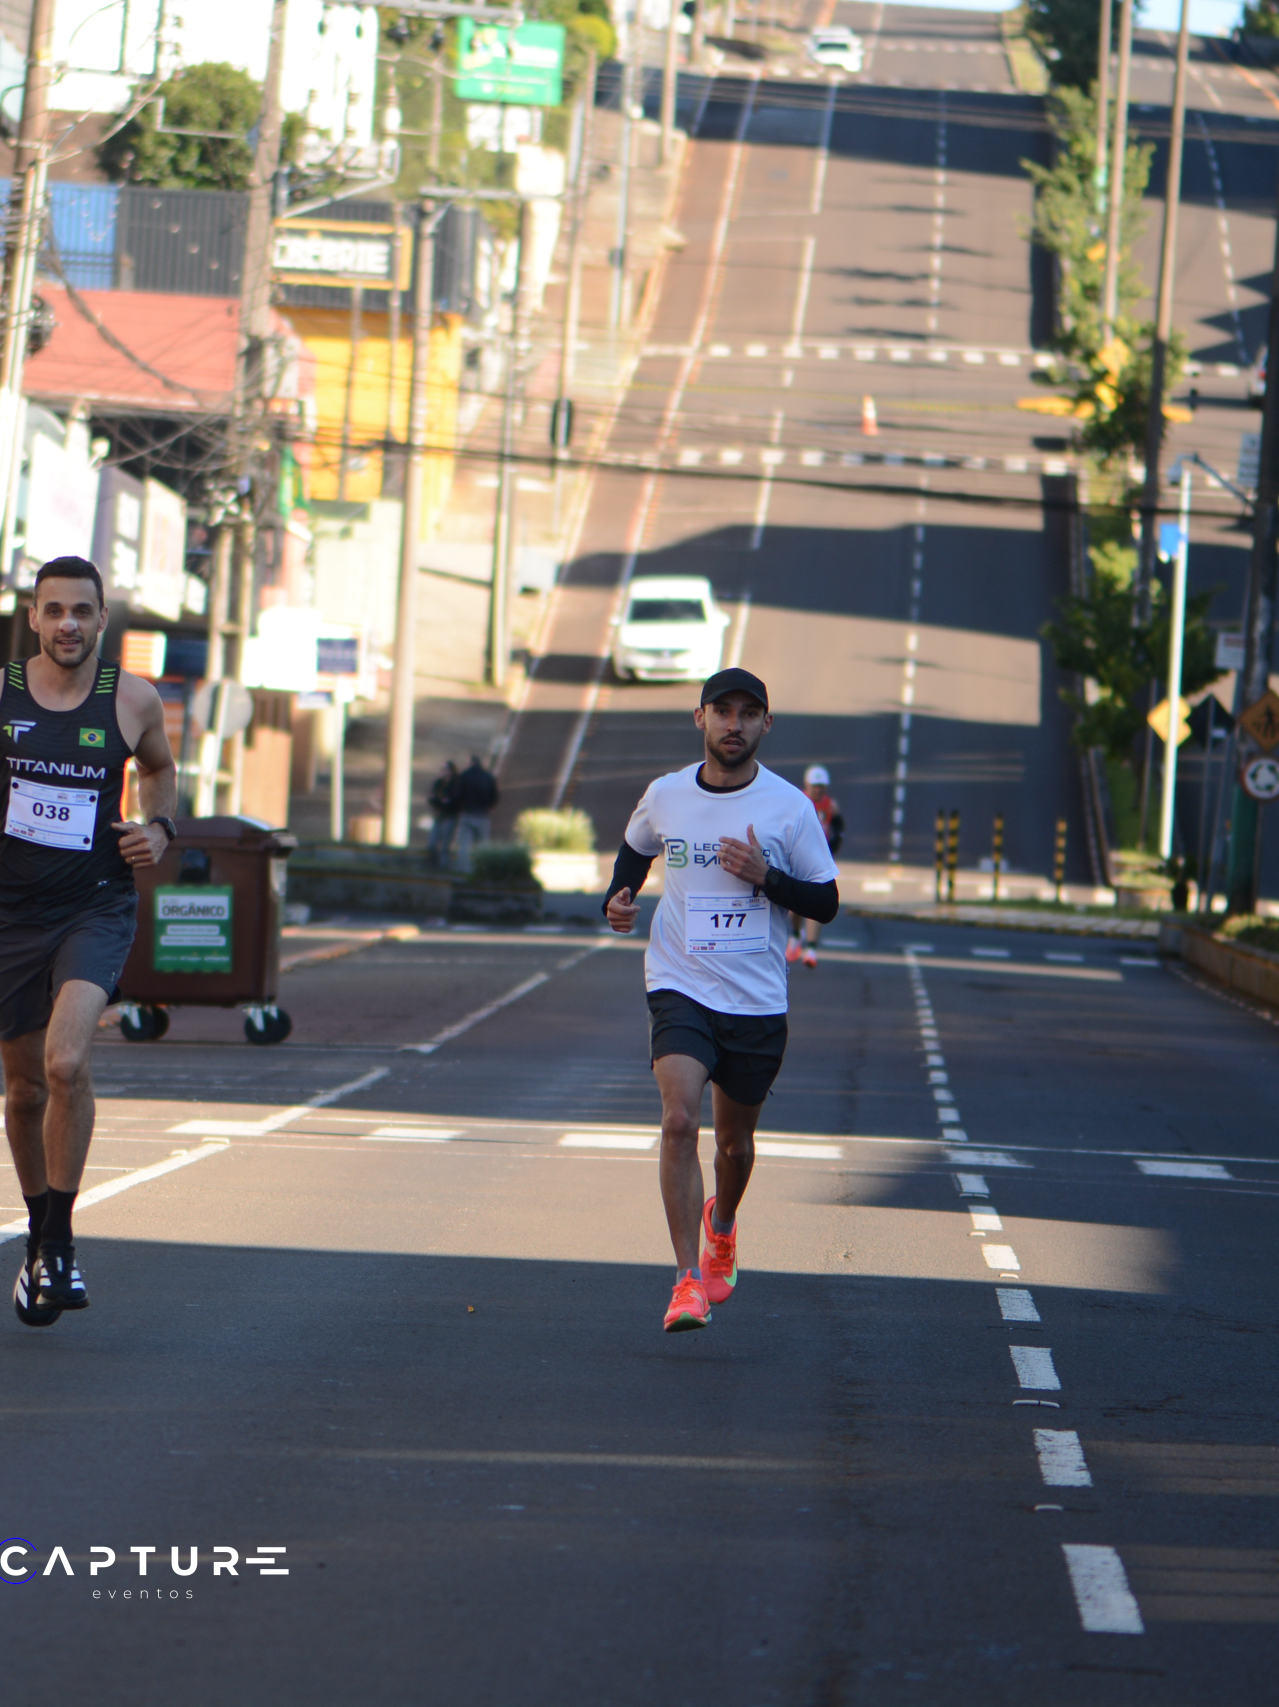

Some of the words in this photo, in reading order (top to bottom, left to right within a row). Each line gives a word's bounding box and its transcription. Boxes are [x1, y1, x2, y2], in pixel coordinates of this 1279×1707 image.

[6, 757, 106, 779] TITANIUM
[32, 802, 70, 821] 038
[162, 902, 225, 917] ORGÂNICO
[710, 913, 747, 928] 177
